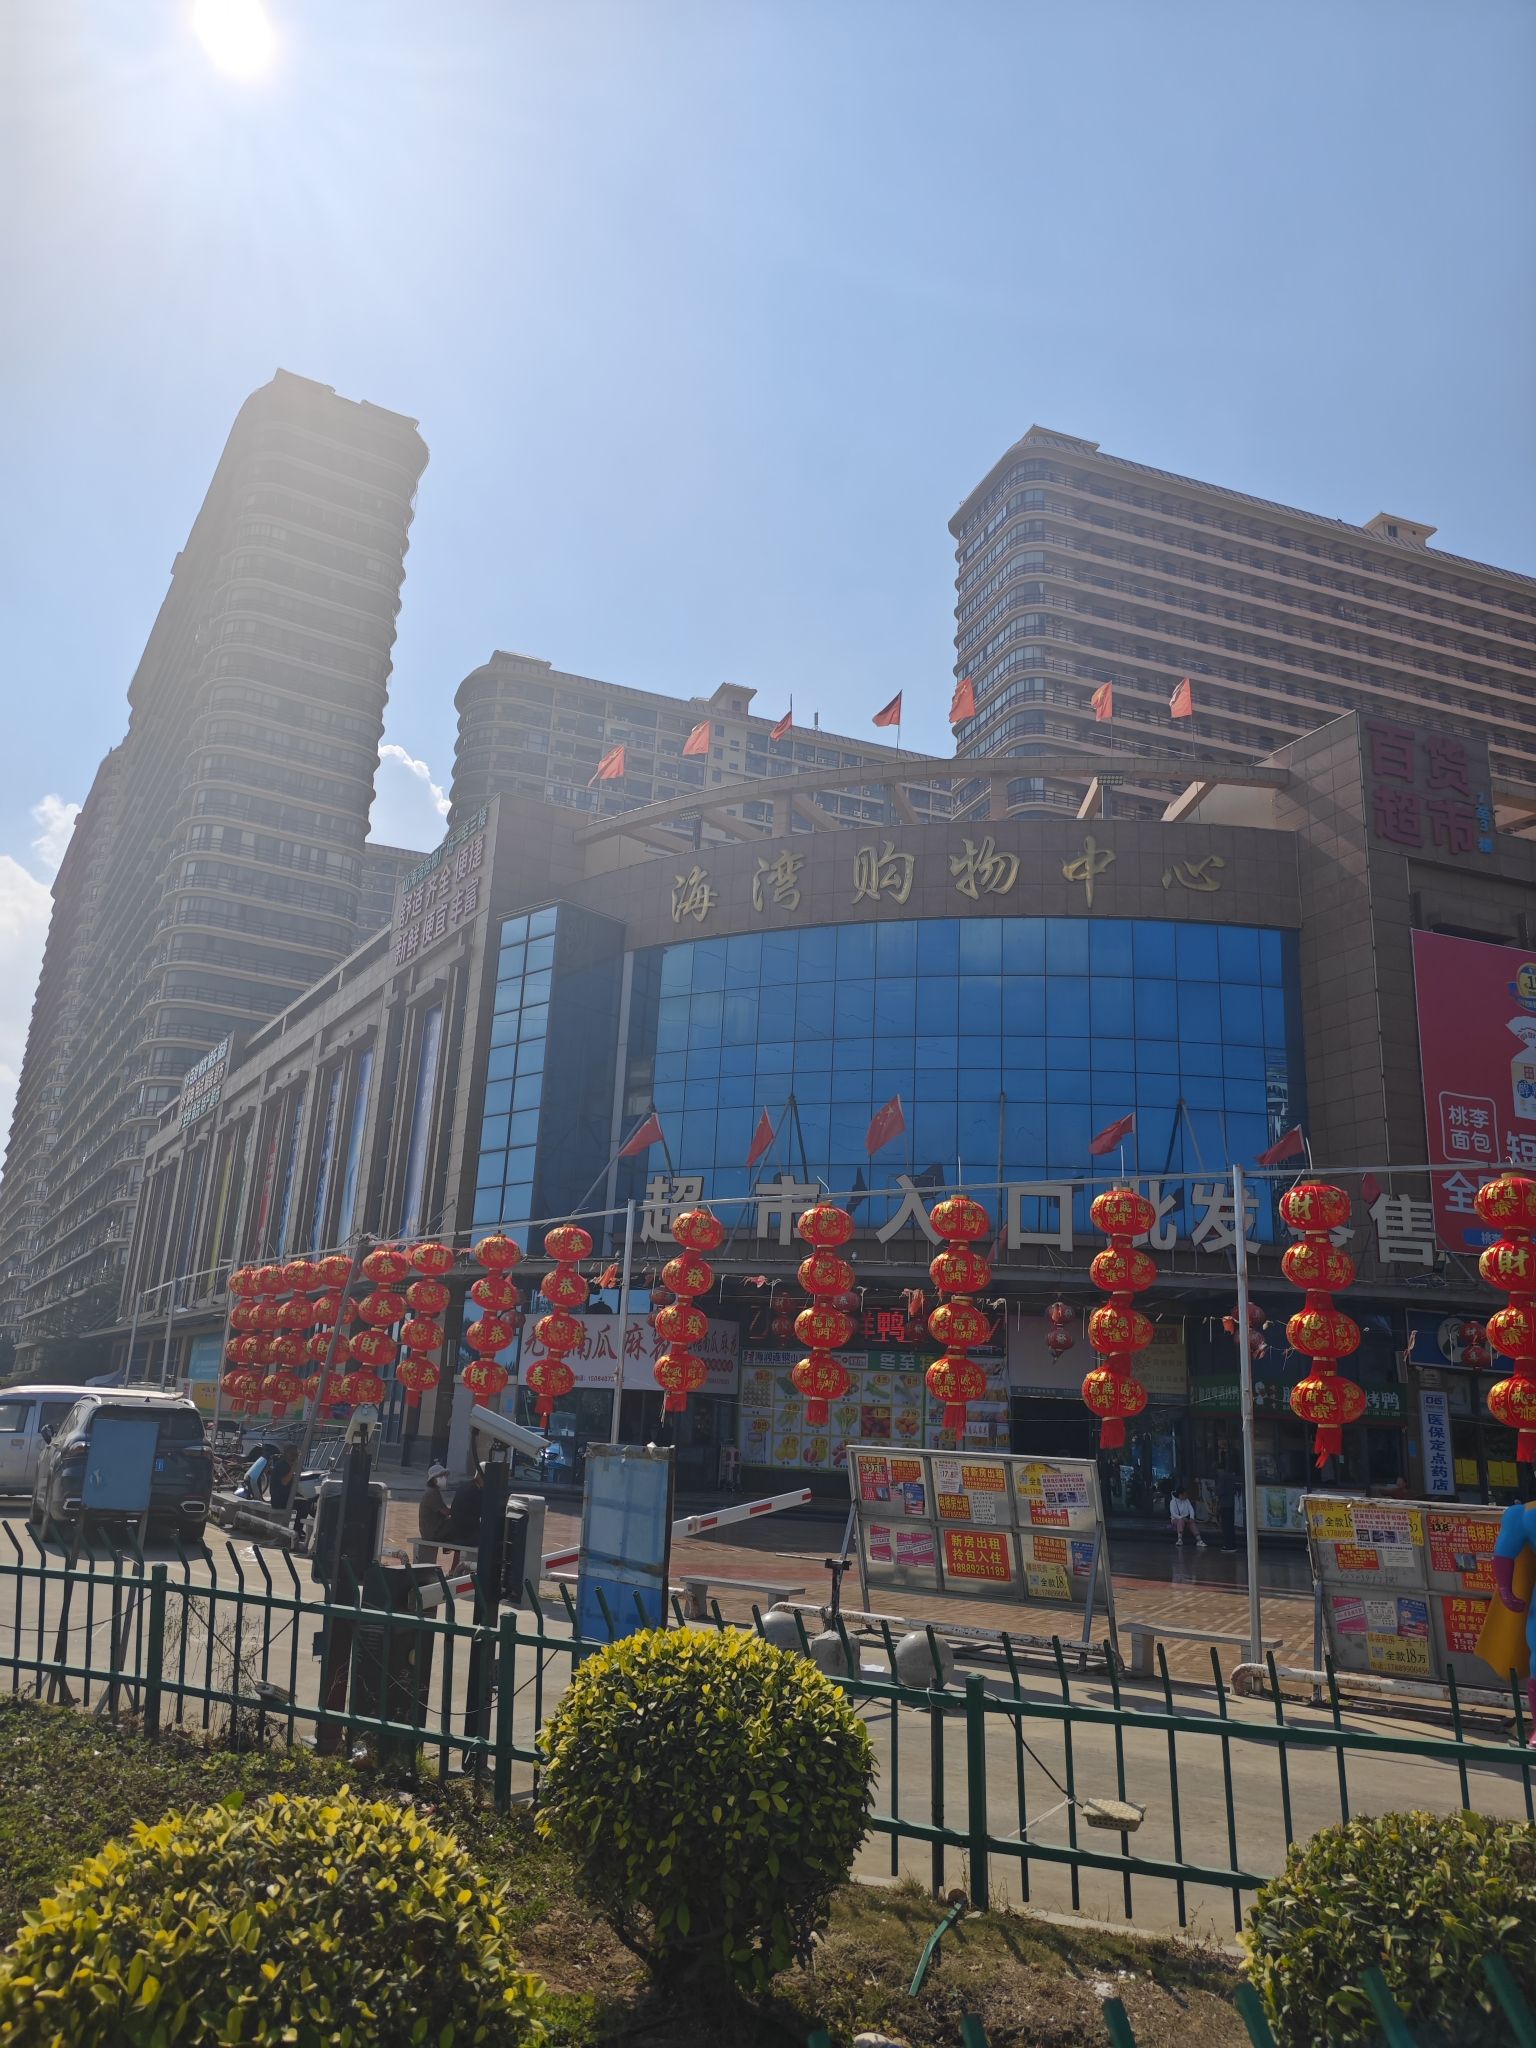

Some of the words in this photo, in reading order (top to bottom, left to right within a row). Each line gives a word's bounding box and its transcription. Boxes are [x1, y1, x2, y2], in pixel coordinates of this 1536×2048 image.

[1366, 720, 1471, 797] 百货
[1373, 785, 1476, 856] 超市
[399, 882, 425, 929] 舒适
[425, 863, 451, 908] 齐全
[455, 834, 486, 883] 便捷
[671, 834, 1226, 923] 海湾购物中心
[394, 922, 420, 967] 新鲜
[421, 902, 448, 946] 便宜
[449, 878, 480, 925] 丰富
[1448, 1104, 1489, 1129] 桃李
[1450, 1129, 1492, 1154] 面包
[640, 1172, 1436, 1267] 超市入口发售
[1427, 1413, 1449, 1491] 医保定点药店
[951, 1534, 1001, 1550] 新房出租
[952, 1549, 1003, 1565] 拎包入住
[952, 1563, 1006, 1577] 18889251189
[1386, 1648, 1427, 1664] 全款18万
